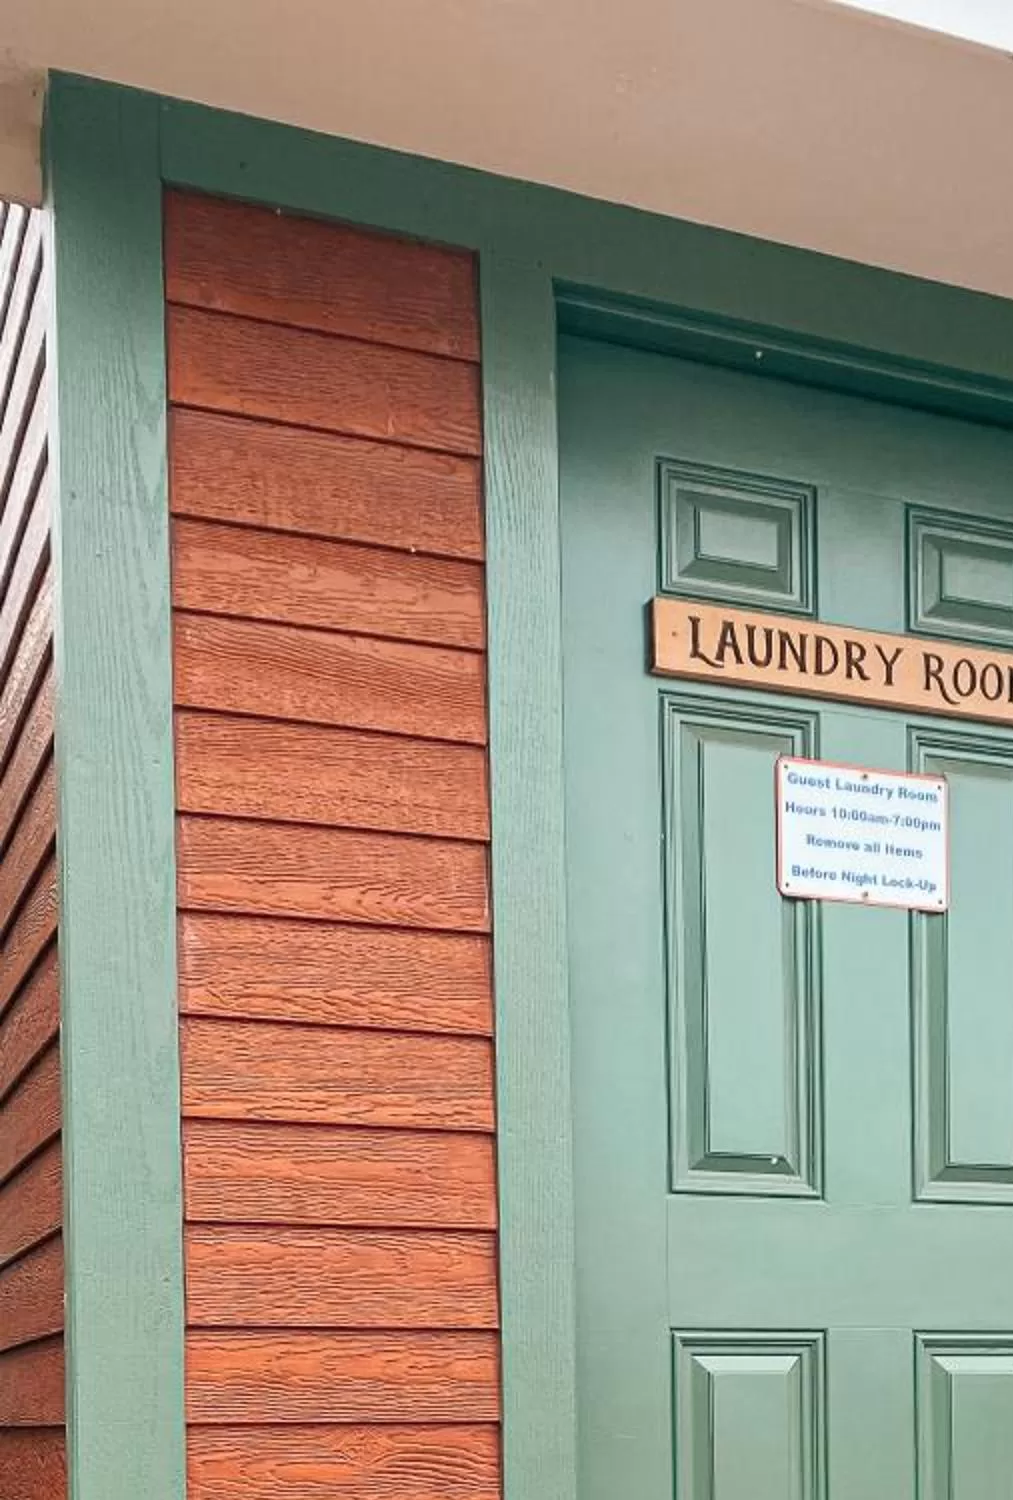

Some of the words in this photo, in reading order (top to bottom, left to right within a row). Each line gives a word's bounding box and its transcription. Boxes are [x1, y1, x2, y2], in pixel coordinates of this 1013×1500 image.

[688, 615, 904, 686] LAUNDRY
[787, 772, 831, 790] Guest
[836, 777, 894, 800] Laundry
[897, 787, 939, 804] Room
[785, 801, 826, 817] Hours
[832, 807, 942, 832] 10:00am-7:00pm
[806, 834, 861, 851] Remove
[864, 842, 881, 854] all
[791, 864, 837, 881] Before
[841, 871, 878, 888] Night
[881, 876, 938, 893] Lock-Up
